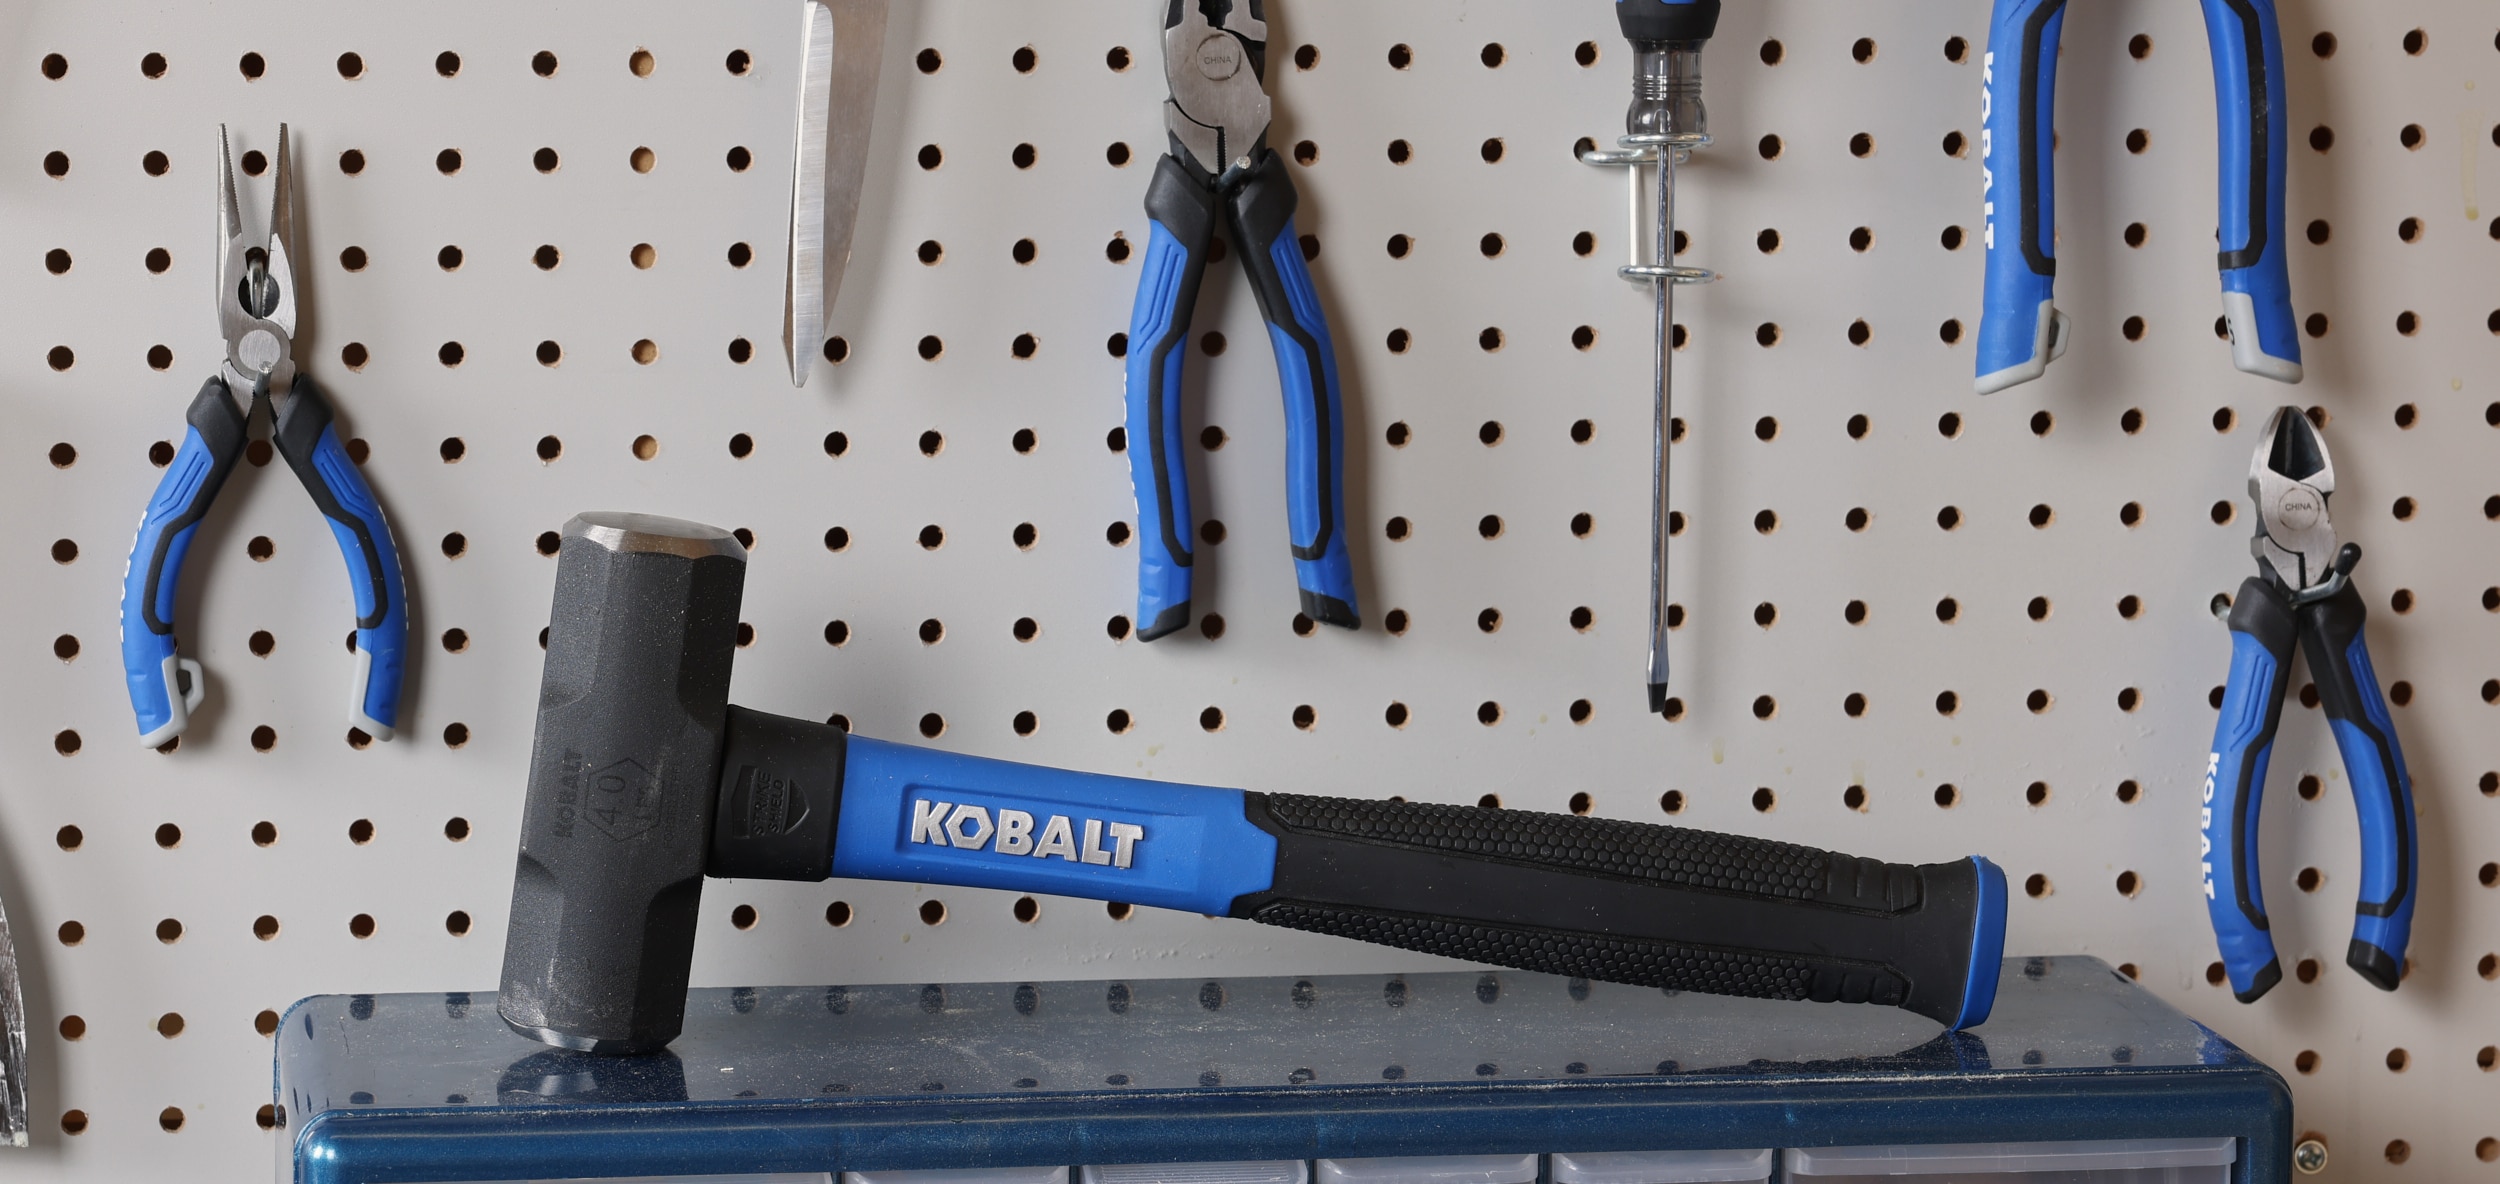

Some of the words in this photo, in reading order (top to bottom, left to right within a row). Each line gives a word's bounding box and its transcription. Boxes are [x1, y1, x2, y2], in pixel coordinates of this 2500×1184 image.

[1203, 56, 1232, 64] CHINA
[2285, 503, 2312, 511] CHINA
[551, 748, 583, 839] KOBALT
[751, 770, 771, 837] STRIKE
[767, 778, 784, 834] SHIELD
[2201, 752, 2221, 900] KOBALT
[911, 799, 1144, 869] KOBALT
